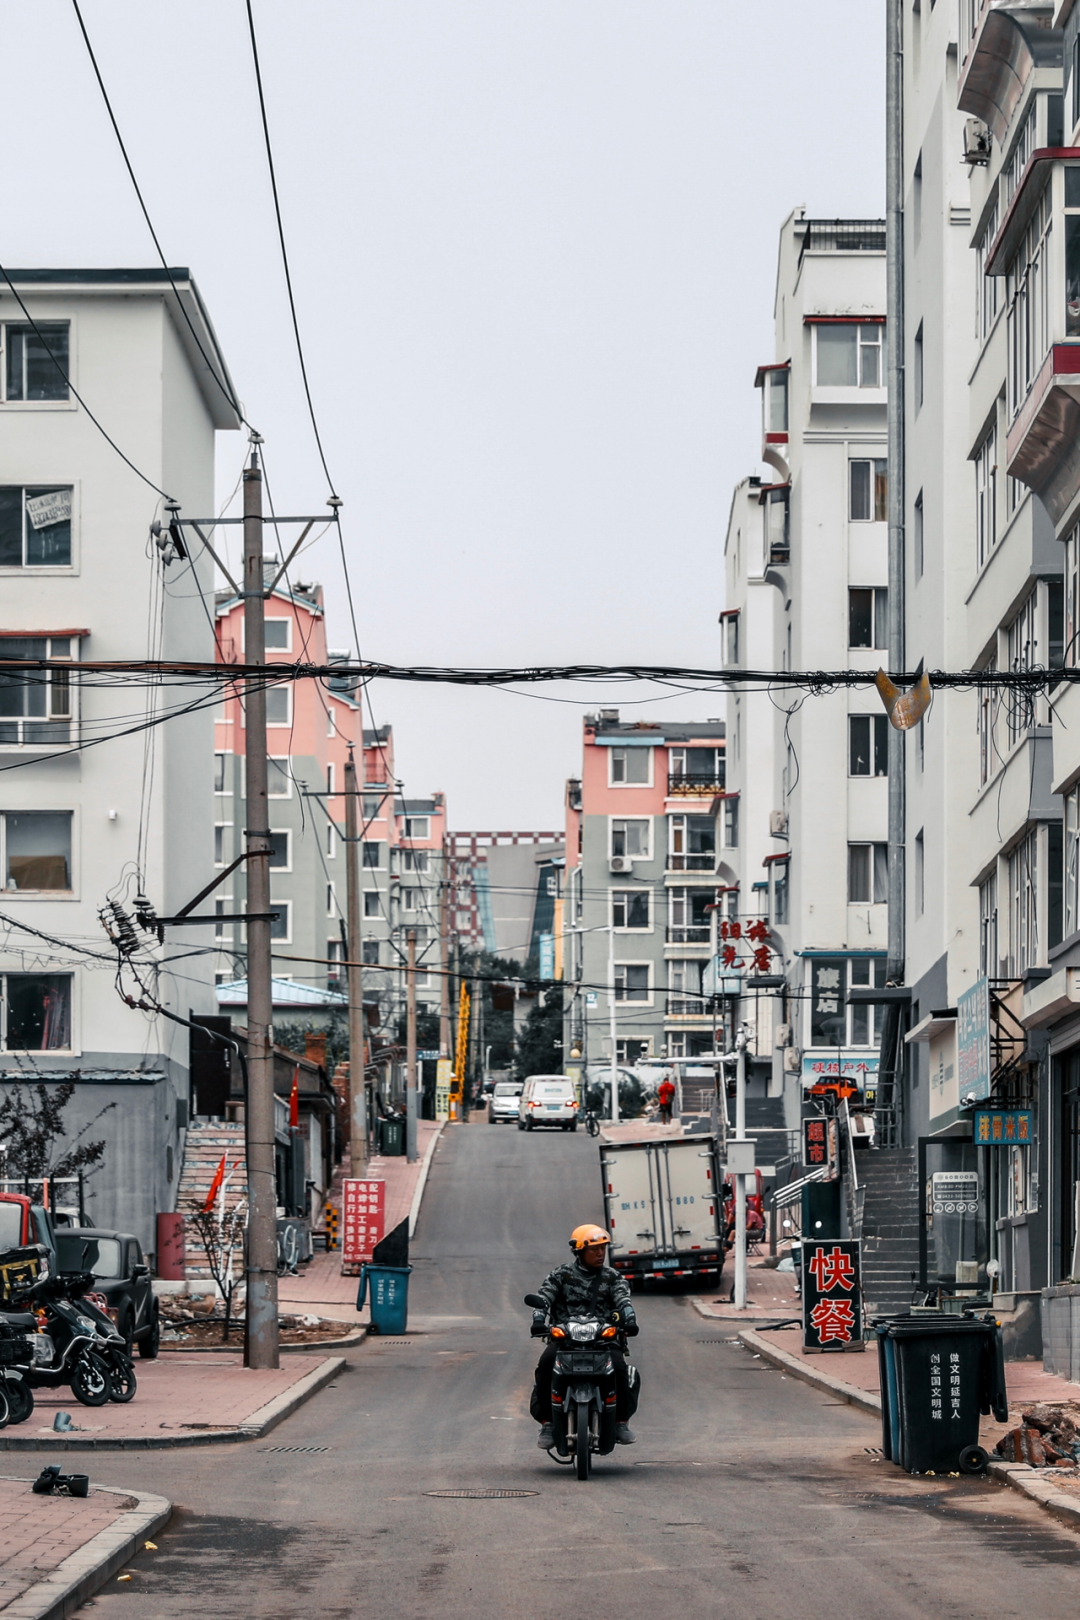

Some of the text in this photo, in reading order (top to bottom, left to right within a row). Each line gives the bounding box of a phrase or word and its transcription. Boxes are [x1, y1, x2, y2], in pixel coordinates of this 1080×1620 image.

[816, 967, 840, 1013] 旅店
[811, 1061, 870, 1075] 硬核户外
[807, 1121, 825, 1163] 超市
[978, 1114, 1029, 1142] 排骨米饭
[809, 1246, 855, 1344] 快餐
[930, 1353, 942, 1419] 创全国文明城
[949, 1352, 961, 1419] 做文明延吉人
